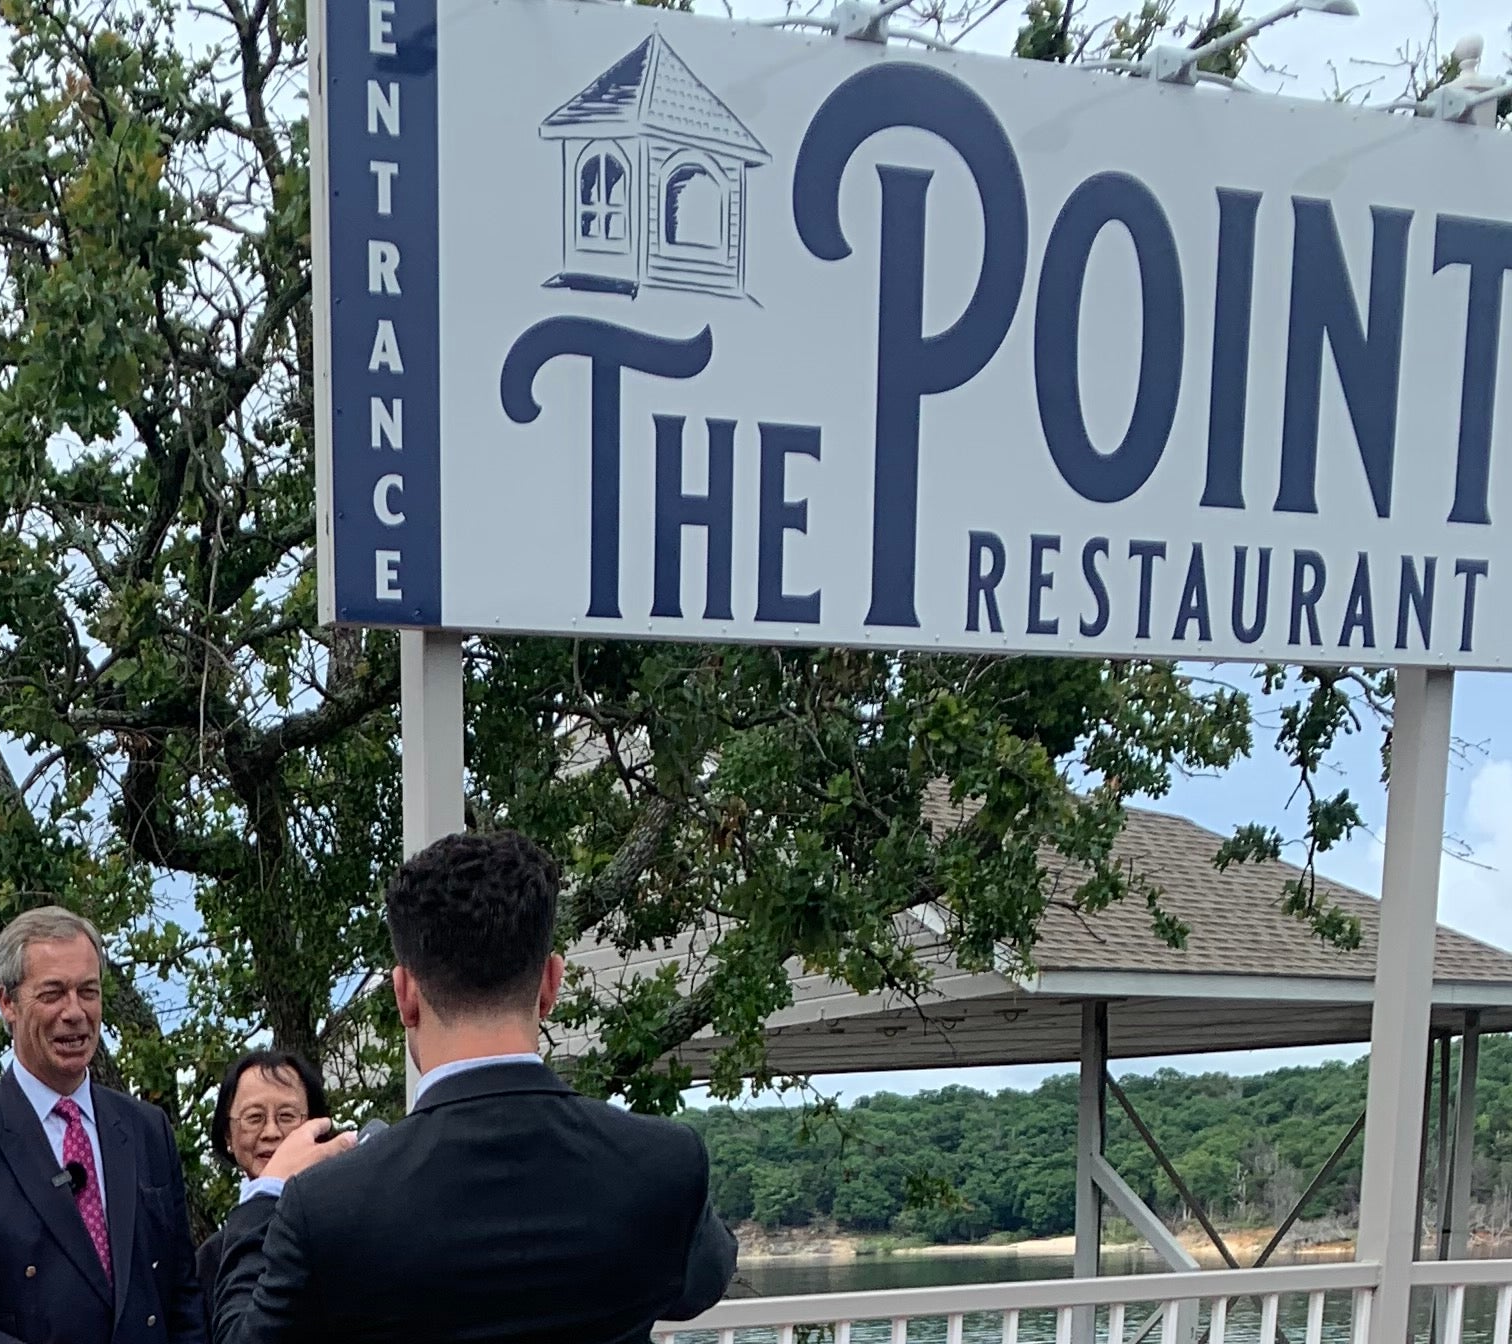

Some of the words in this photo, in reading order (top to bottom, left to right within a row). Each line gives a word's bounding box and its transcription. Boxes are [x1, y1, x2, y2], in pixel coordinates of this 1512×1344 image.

[367, 0, 406, 603] ENTRANCE
[499, 315, 823, 626] THE
[792, 61, 1512, 630] POINT
[964, 530, 1490, 653] RESTAURANT
